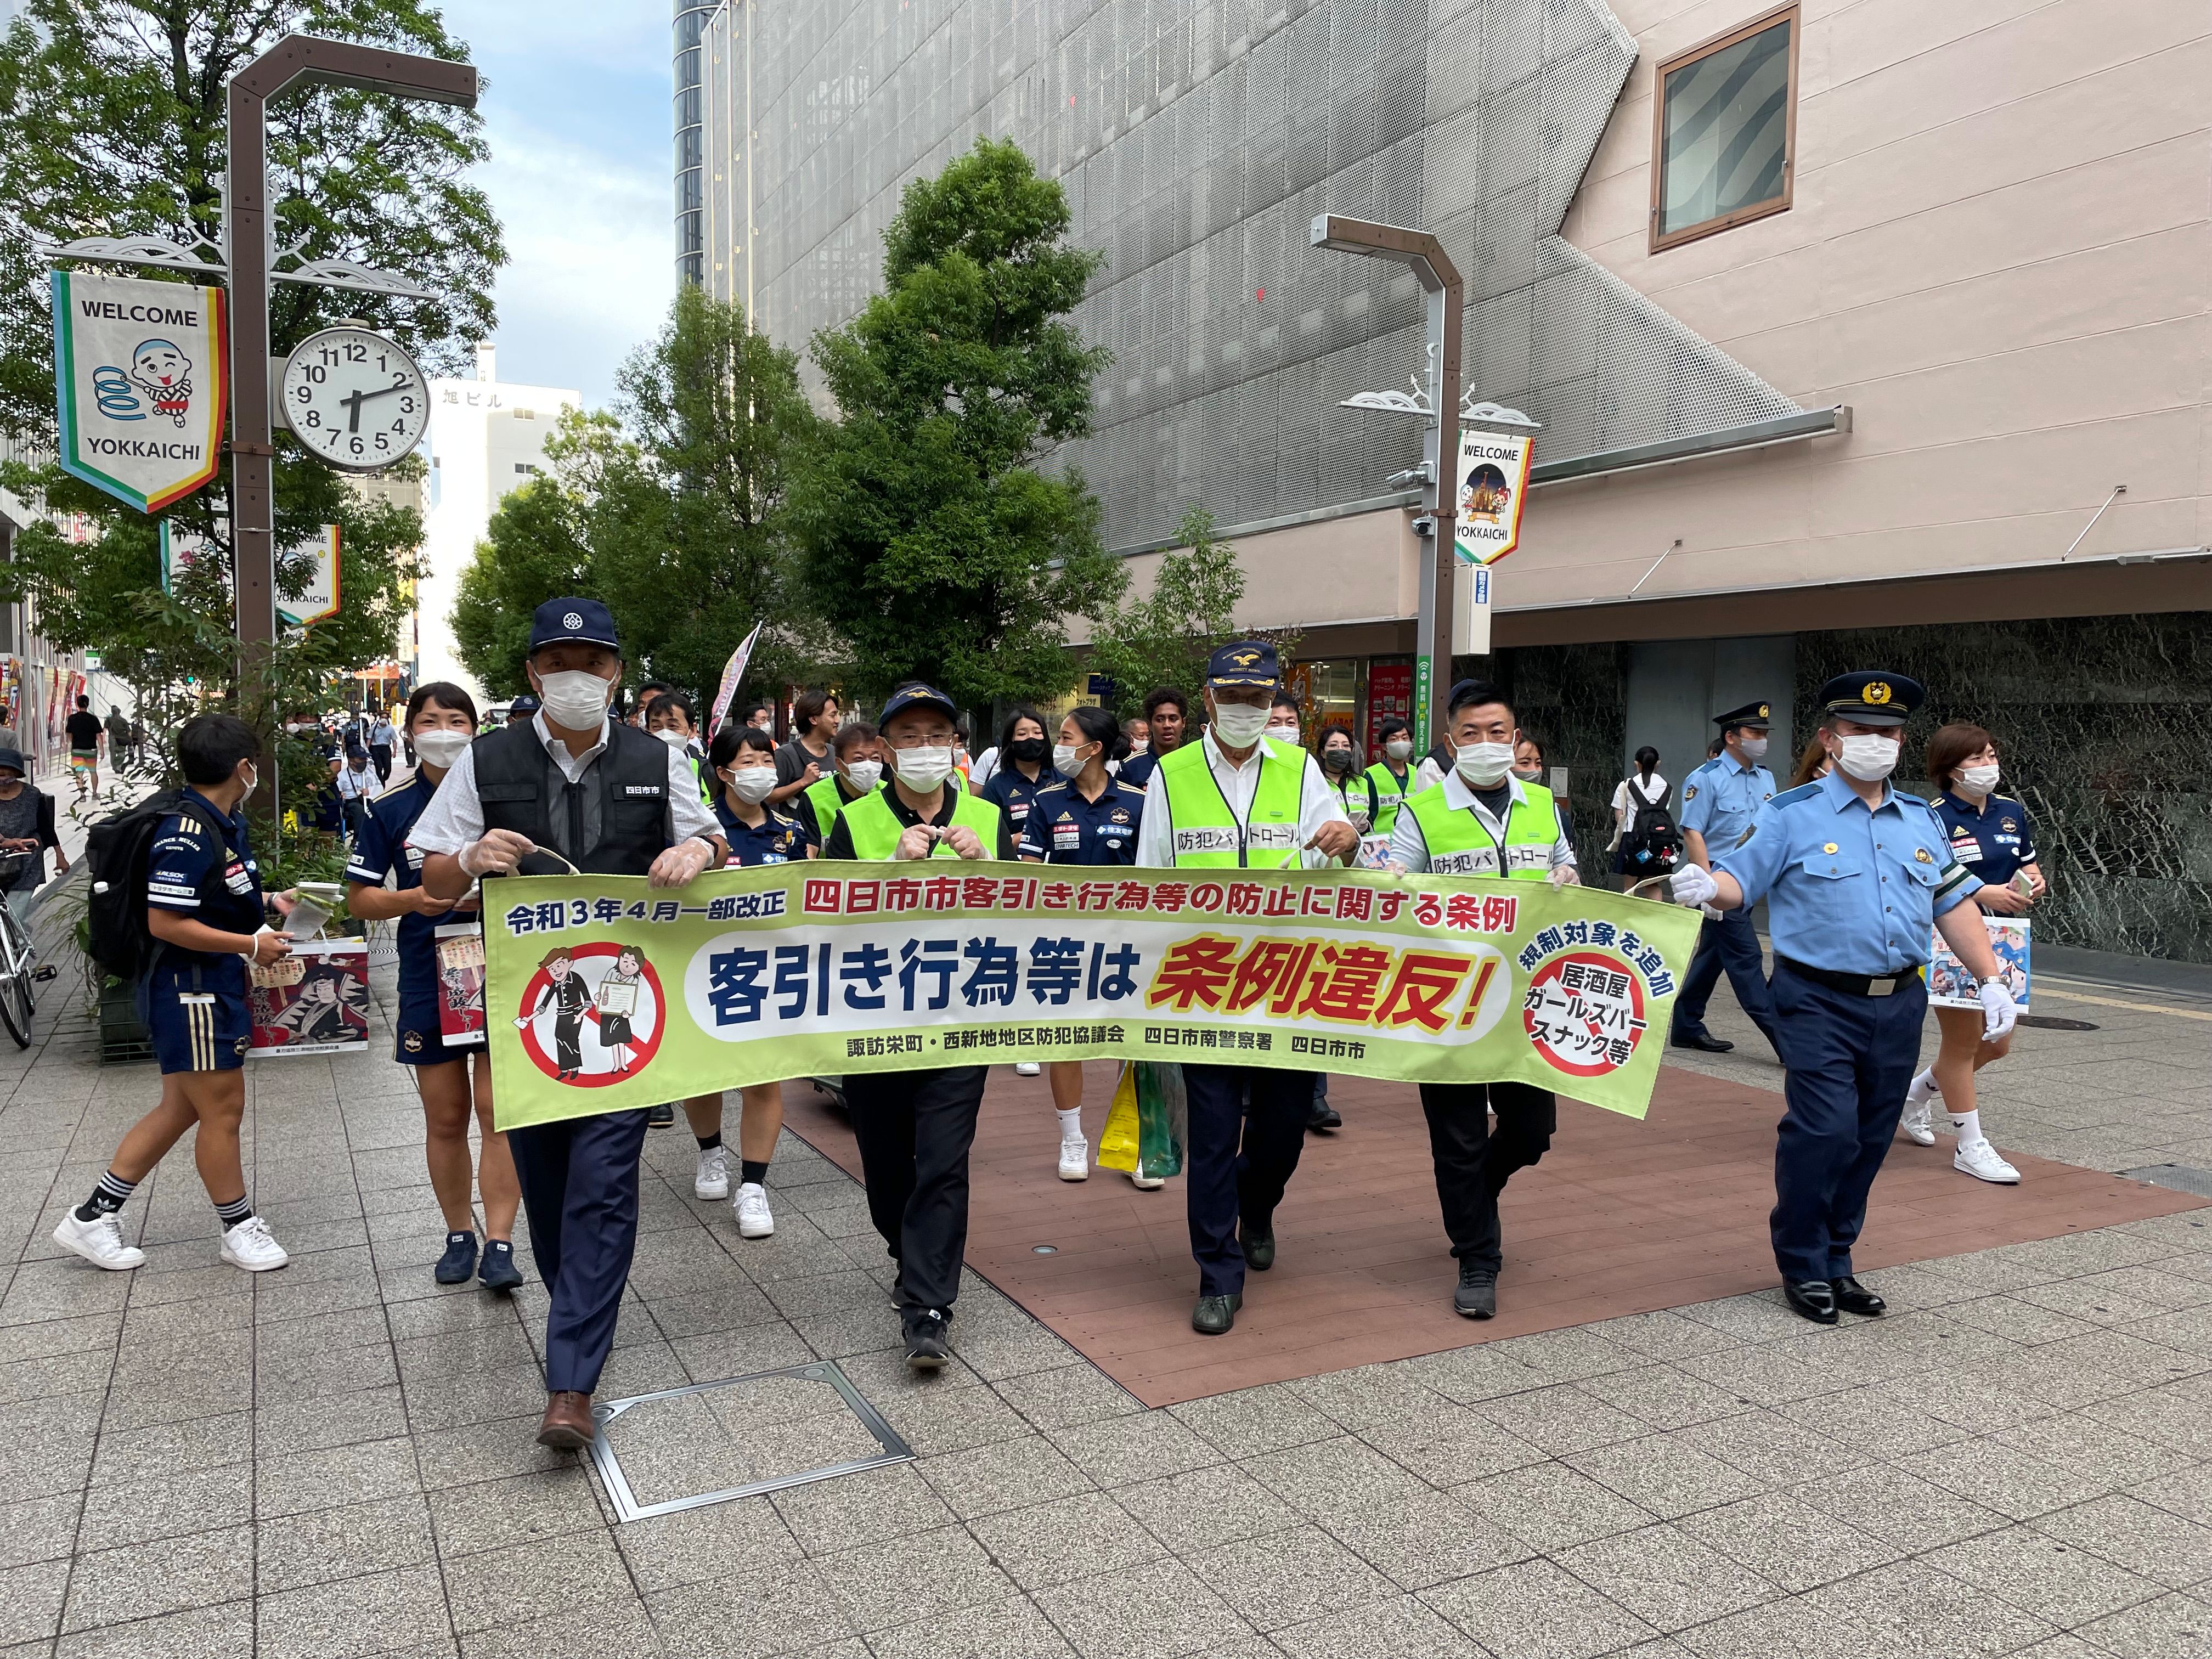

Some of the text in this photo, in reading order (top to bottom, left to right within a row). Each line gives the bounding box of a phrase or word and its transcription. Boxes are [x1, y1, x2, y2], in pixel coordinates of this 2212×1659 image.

[82, 300, 198, 327] WELCOME
[319, 348, 338, 366] 11
[342, 343, 367, 363] 12
[376, 355, 386, 373] 1
[301, 364, 326, 383] 10
[392, 372, 407, 388] 2
[297, 386, 312, 404] 9
[443, 389, 502, 408] 旭ビル
[400, 396, 414, 414] 3
[306, 410, 321, 428] 8
[391, 418, 406, 435] 4
[326, 428, 341, 445] 7
[349, 437, 364, 454] 6
[374, 432, 388, 449] 5
[87, 437, 200, 460] YOKKAICHI
[1464, 444, 1519, 461] WELCOME
[1457, 525, 1508, 540] YOKKAICHI
[625, 786, 660, 794] 四日市市
[507, 876, 1517, 934] 令和3年4月一部改正 四日市市客引き行為等の防止に関する条例
[1519, 922, 1676, 997] 規制対象を追加
[708, 936, 1497, 1031] 客引き行為等は 条例違反!
[1561, 964, 1630, 1000] 居酒屋
[1525, 989, 1647, 1030] ガールズバー
[847, 1024, 1366, 1059] 諏訪栄町・西新地地区防犯協議会 四日市南警察署 四日市市
[1531, 1019, 1632, 1065] スナック等
